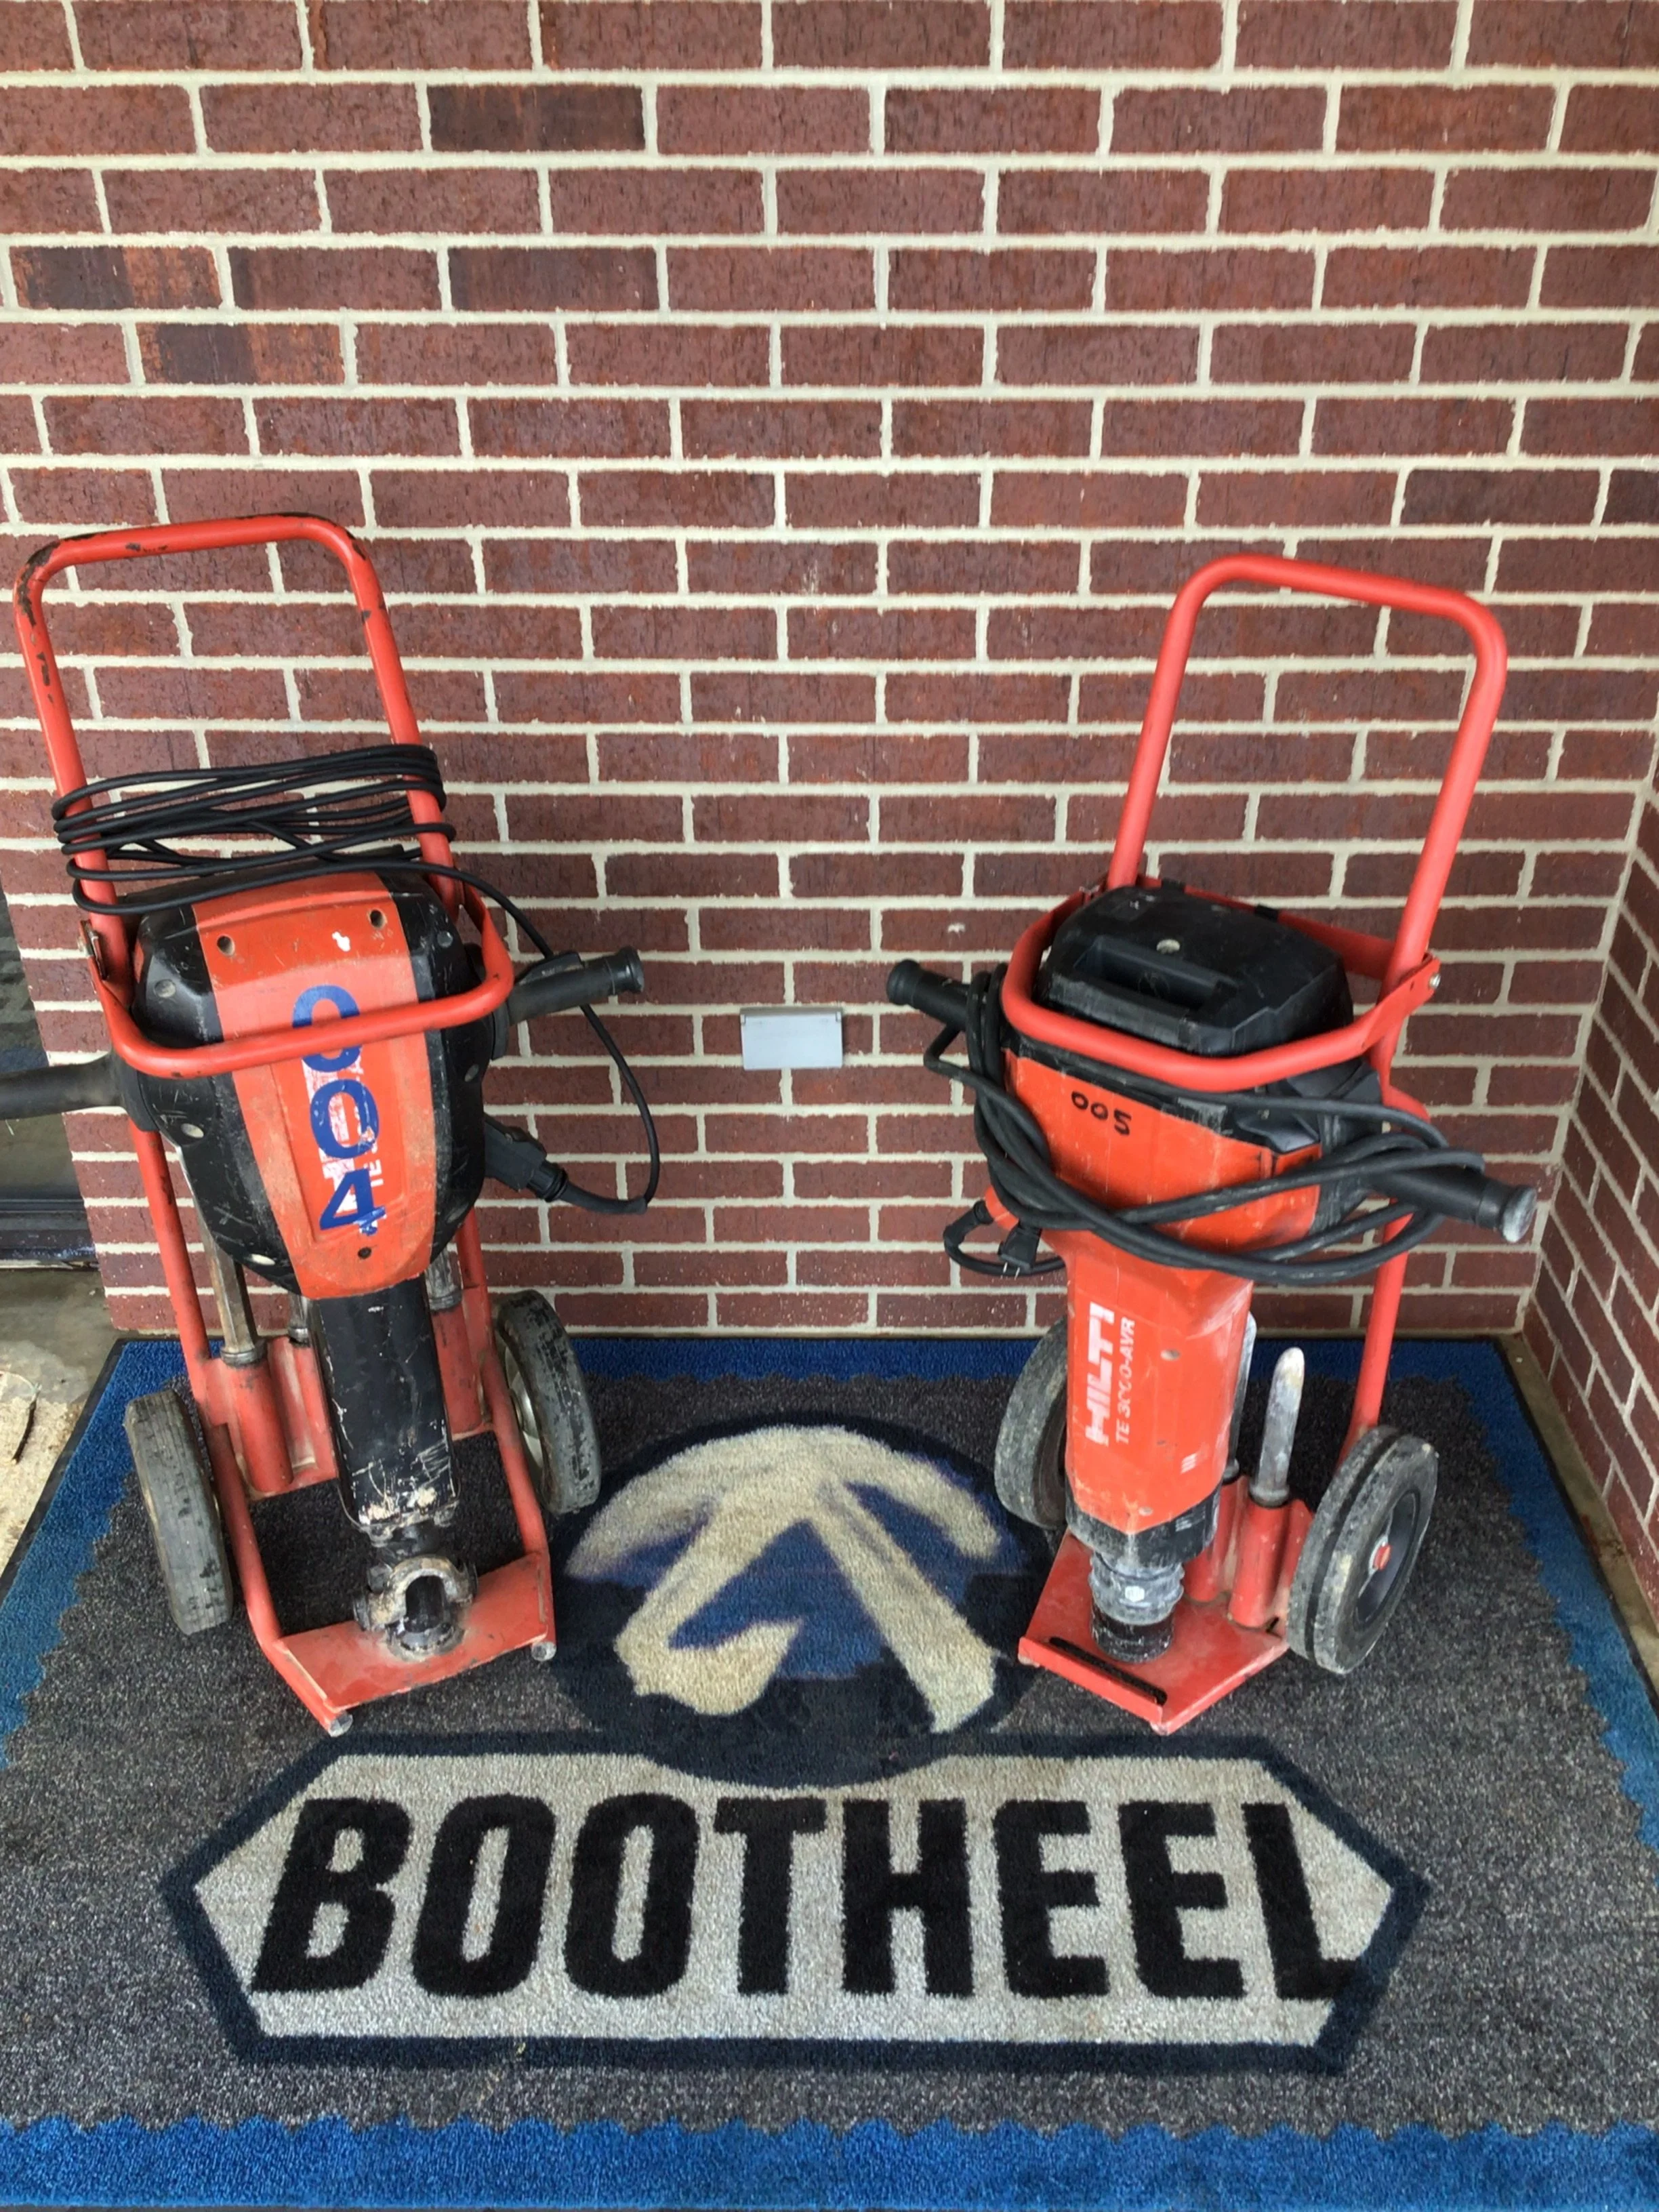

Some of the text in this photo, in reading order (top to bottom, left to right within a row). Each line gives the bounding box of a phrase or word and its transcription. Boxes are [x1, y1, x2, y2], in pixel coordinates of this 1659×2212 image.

[292, 984, 386, 1235] 004
[1071, 1090, 1131, 1135] 005
[1086, 1301, 1115, 1447] HILTI
[1116, 1418, 1130, 1445] TE
[251, 1793, 1362, 2001] BOOTHEEL
